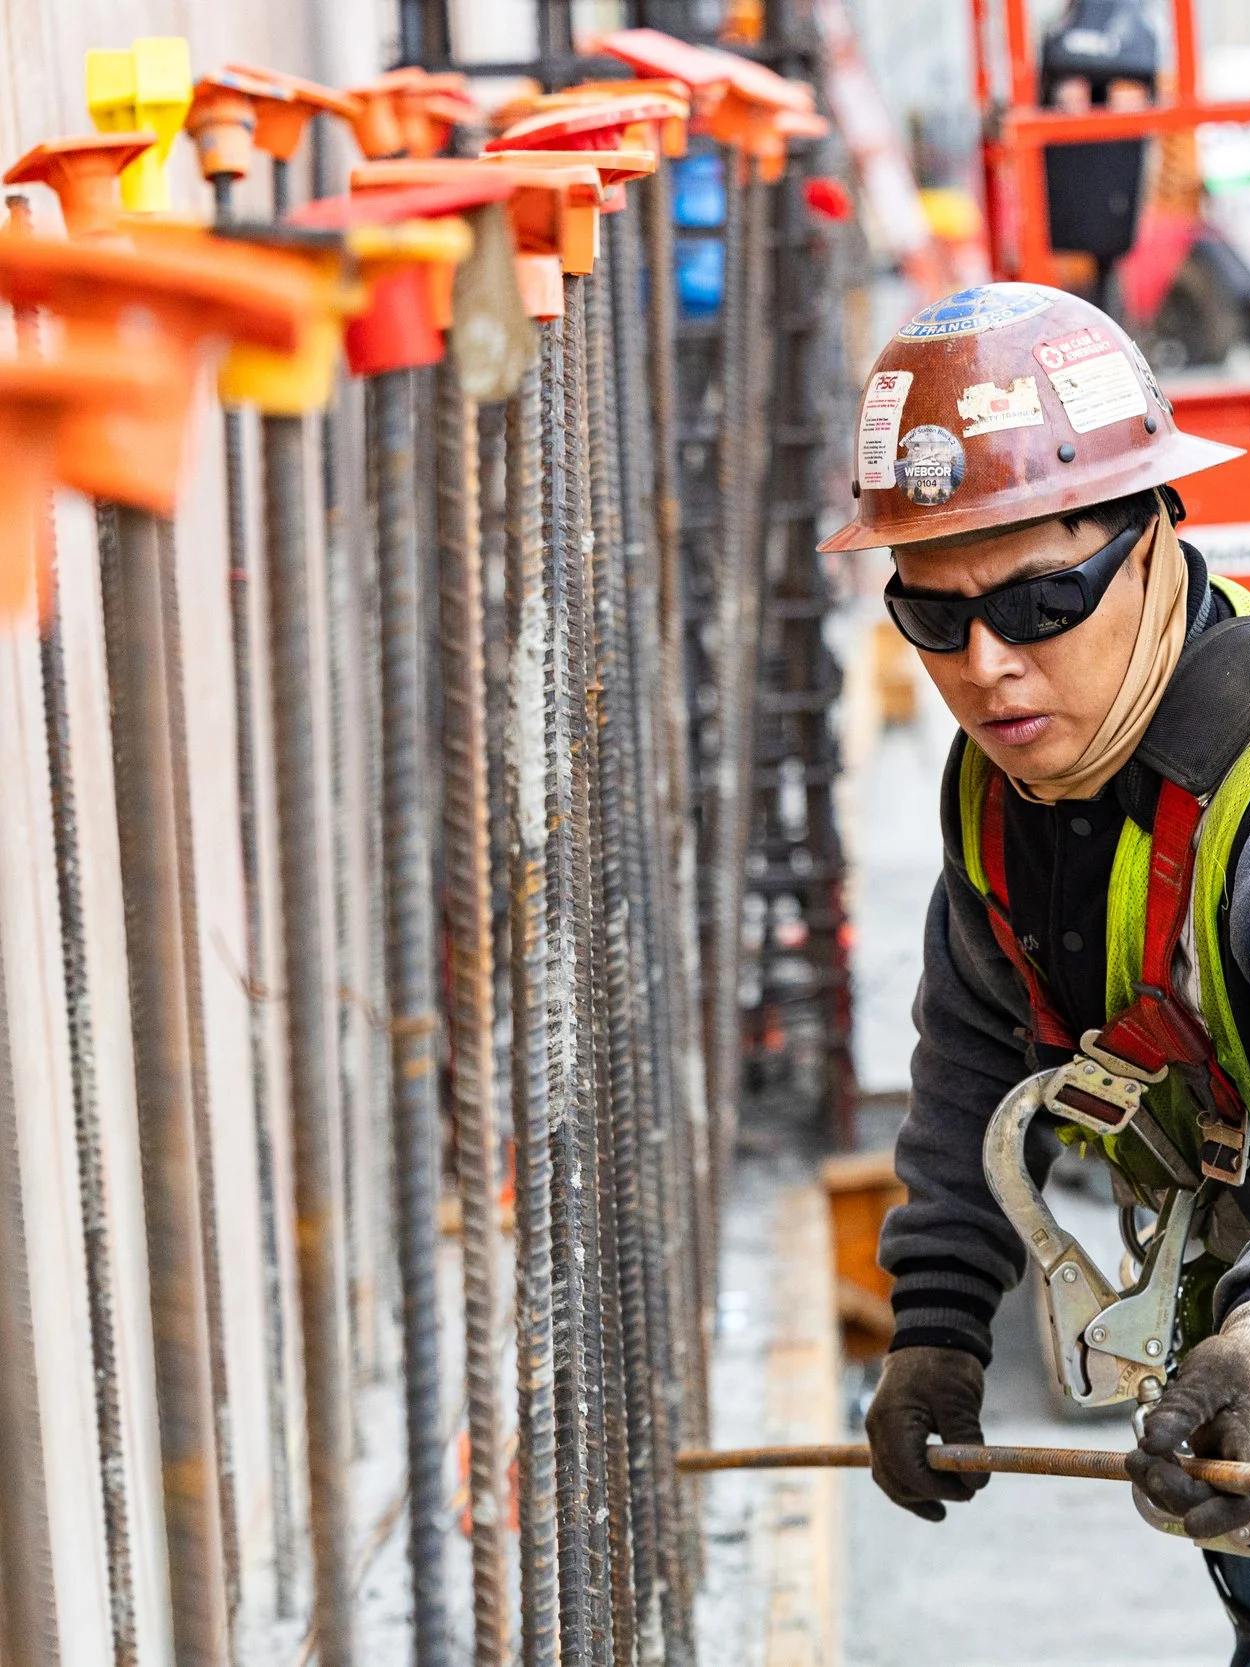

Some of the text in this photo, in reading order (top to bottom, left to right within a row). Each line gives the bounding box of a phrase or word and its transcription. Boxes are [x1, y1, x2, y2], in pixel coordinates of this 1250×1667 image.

[918, 310, 1015, 335] FRANCISCO
[1066, 341, 1112, 362] EMERGENCY
[904, 466, 952, 477] WEBCOR
[916, 479, 937, 487] 0104
